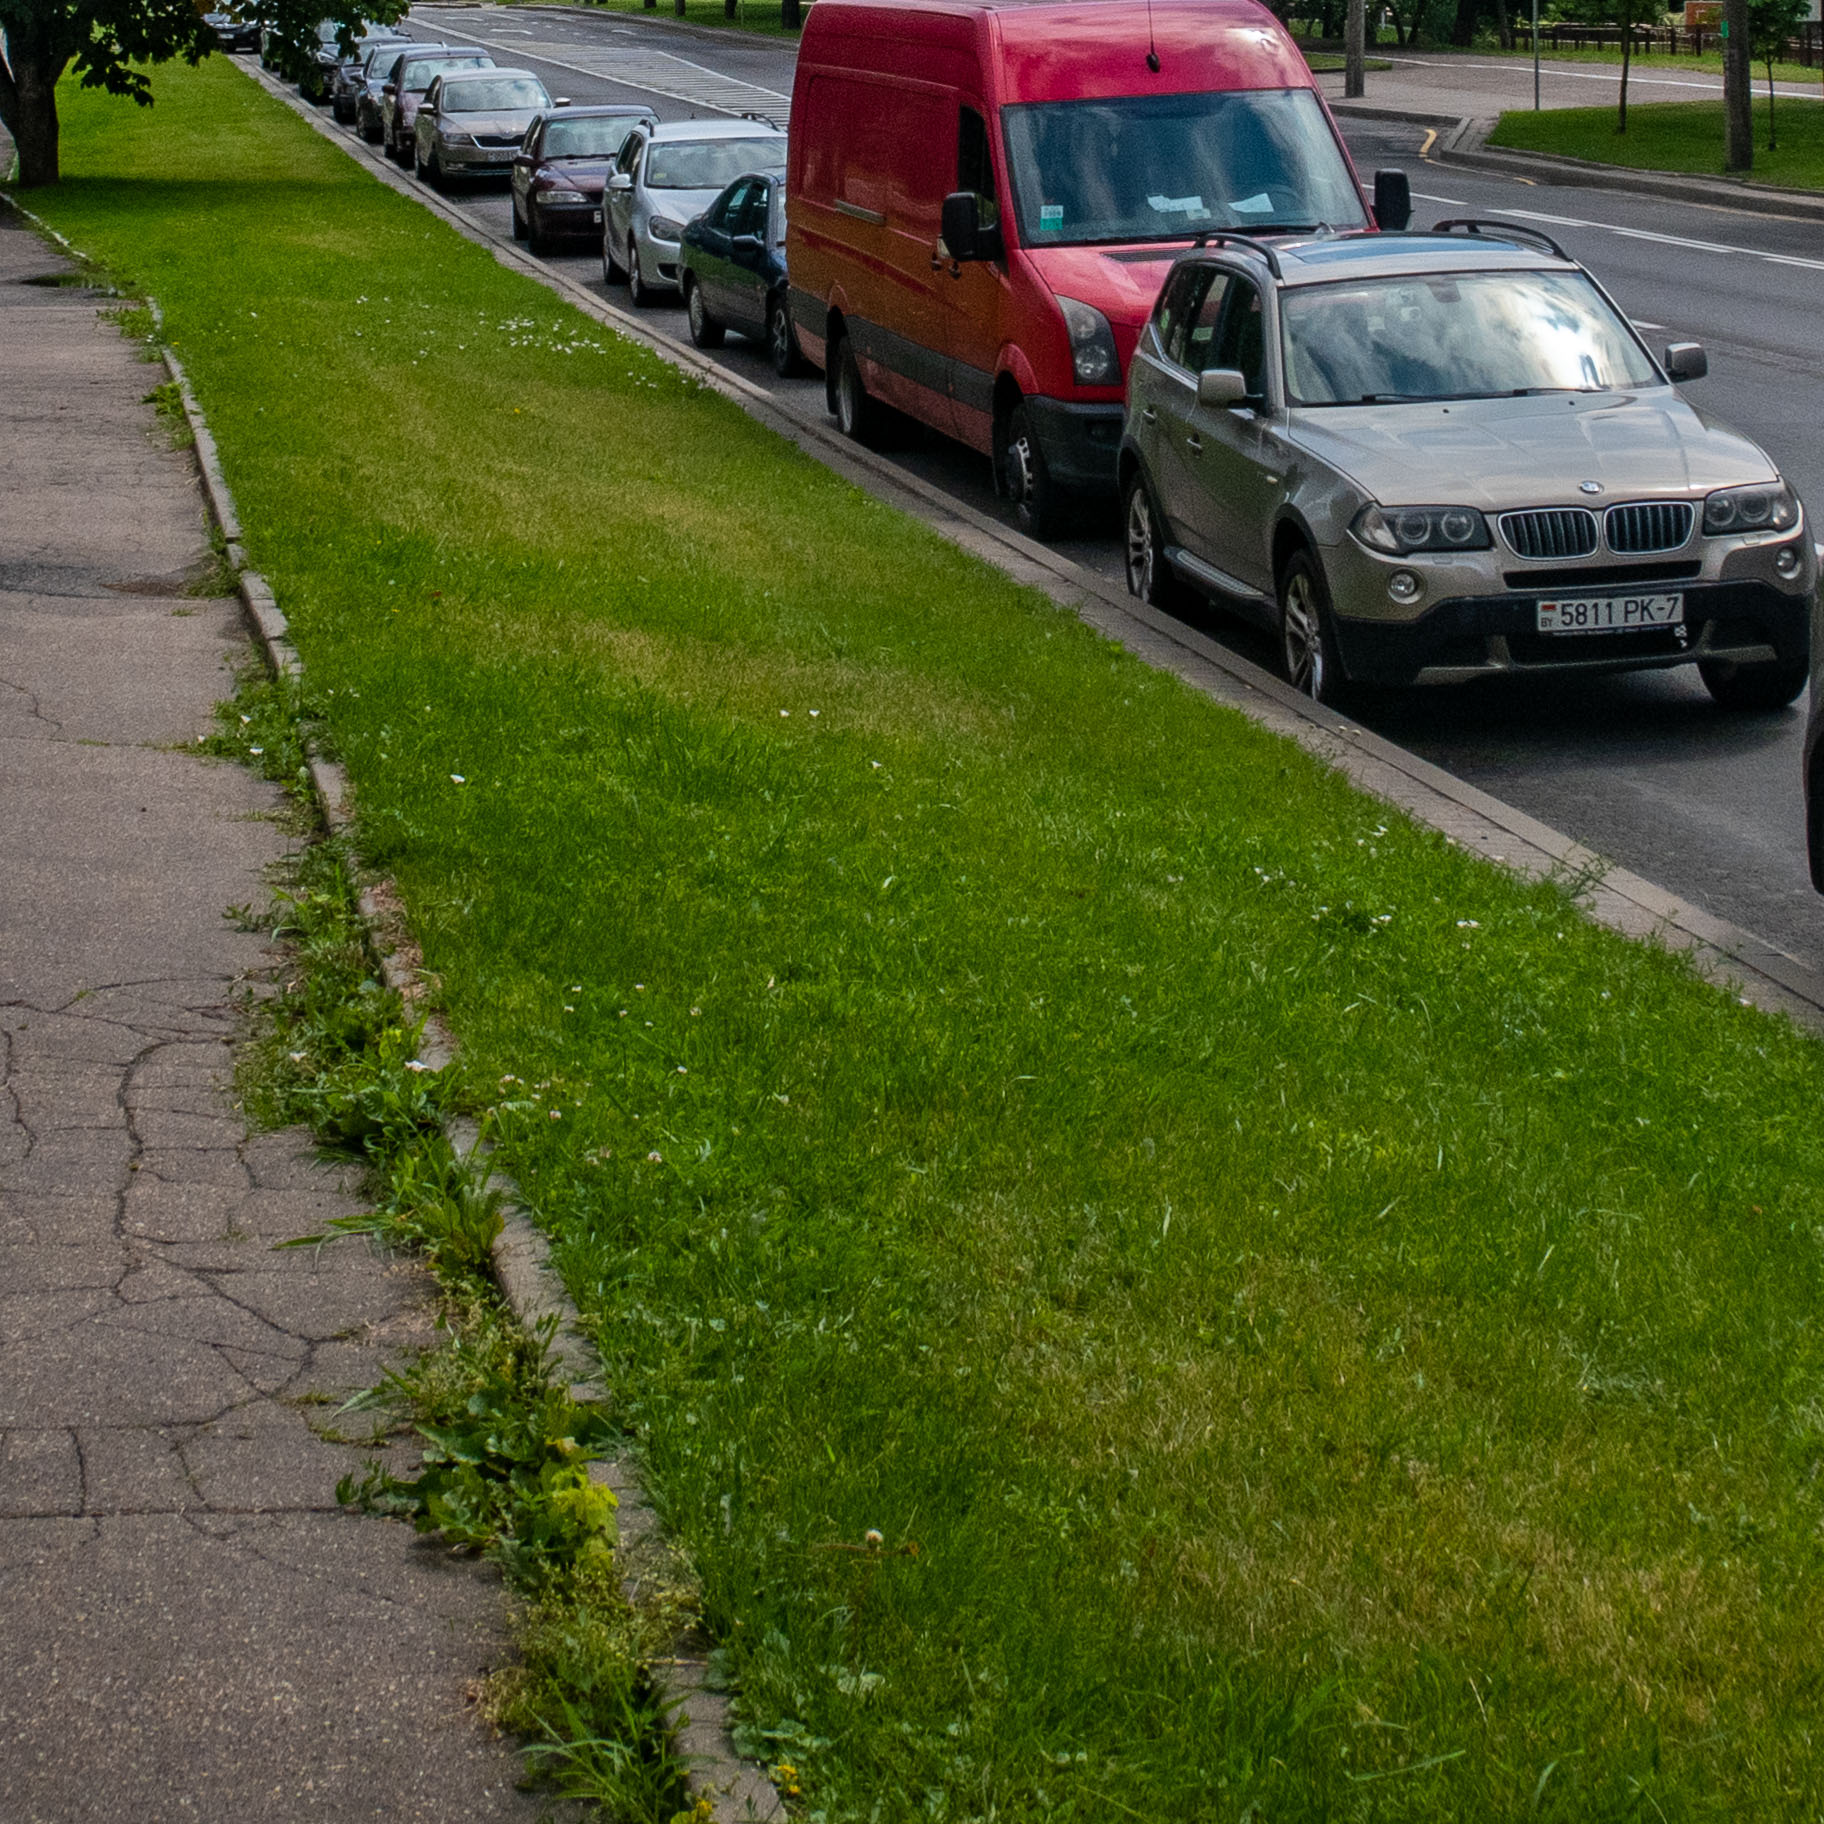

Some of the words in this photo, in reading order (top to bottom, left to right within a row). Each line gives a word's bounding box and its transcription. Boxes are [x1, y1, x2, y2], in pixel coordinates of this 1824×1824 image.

[1561, 601, 1613, 626] 5811
[1624, 597, 1679, 623] PK-7
[1541, 617, 1553, 627] BY
